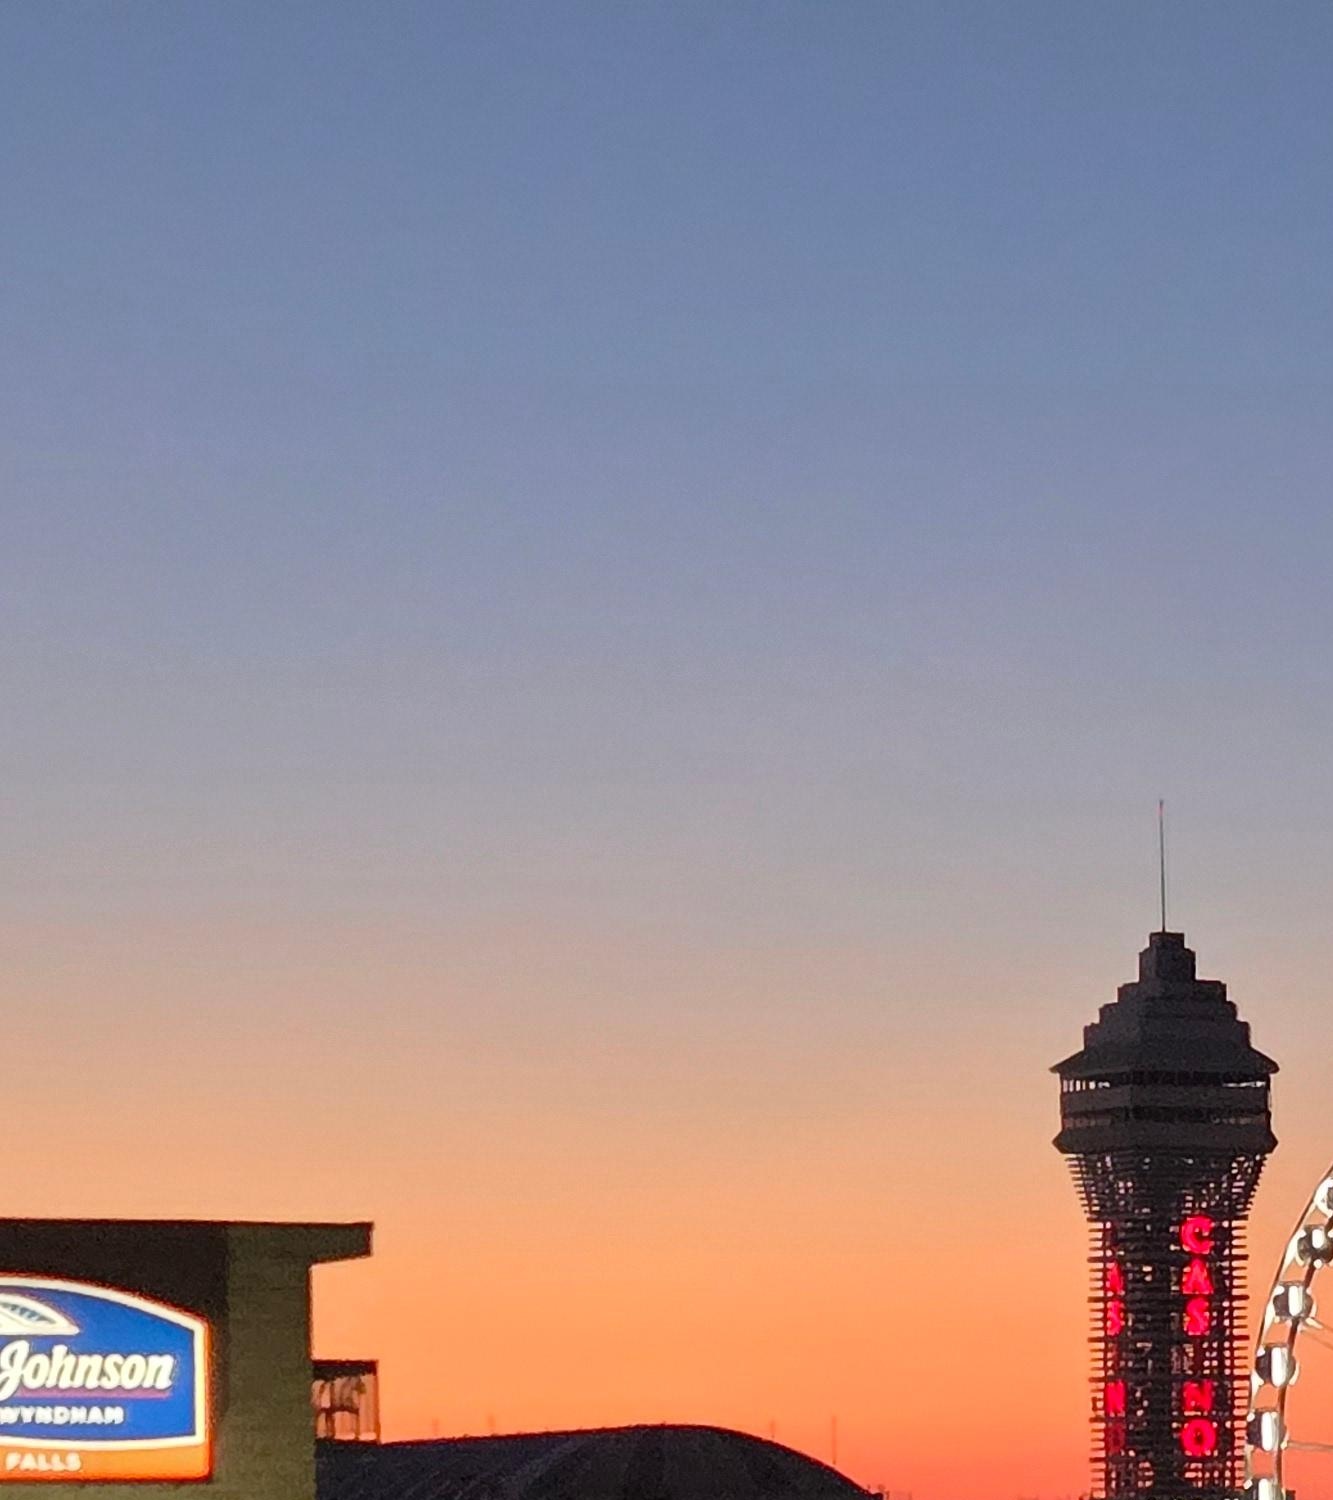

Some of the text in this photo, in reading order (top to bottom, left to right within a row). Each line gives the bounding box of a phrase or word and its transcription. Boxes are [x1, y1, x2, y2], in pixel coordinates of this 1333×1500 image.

[1180, 1215, 1217, 1456] CASNO
[0, 1340, 174, 1401] Johnson
[5, 1452, 82, 1472] FALLS
